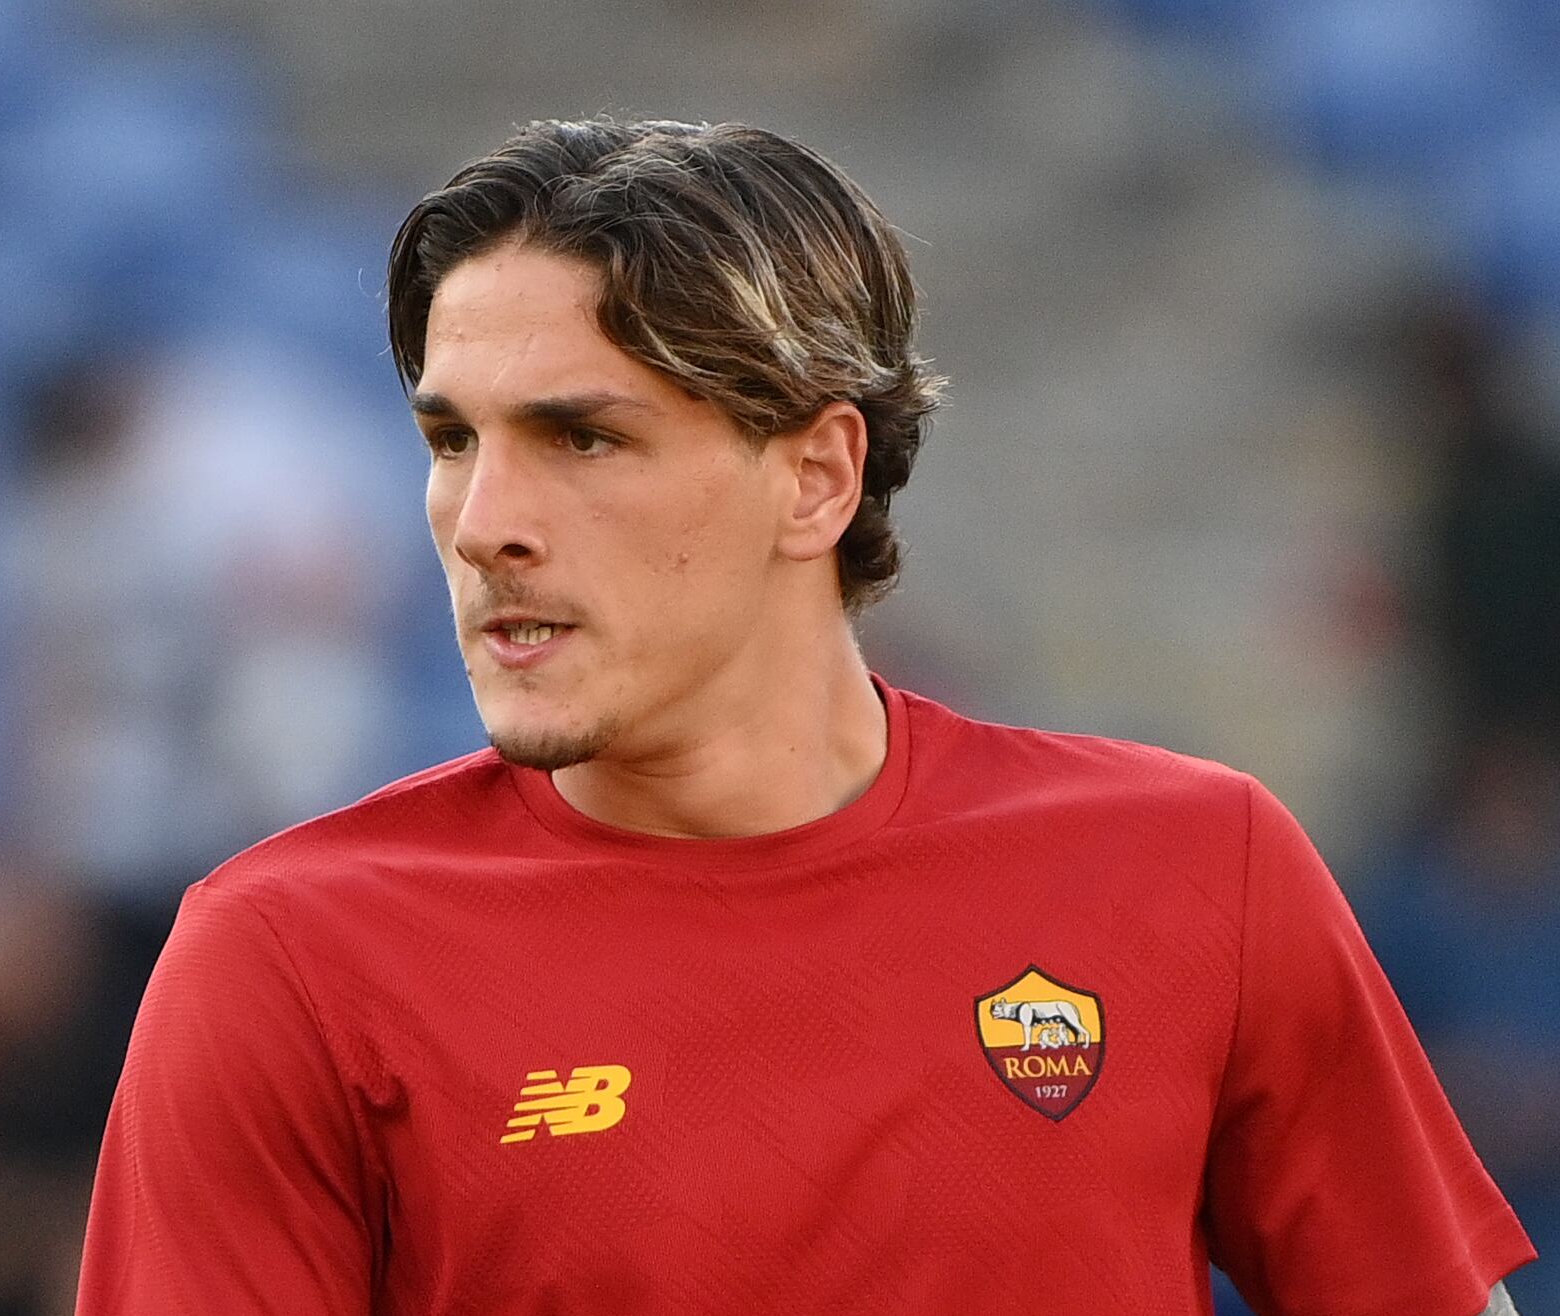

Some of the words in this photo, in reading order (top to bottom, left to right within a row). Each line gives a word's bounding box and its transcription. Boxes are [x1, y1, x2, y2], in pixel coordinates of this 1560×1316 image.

[1003, 1055, 1094, 1079] ROMA
[1035, 1084, 1068, 1099] 1927
[500, 1064, 632, 1144] NB
